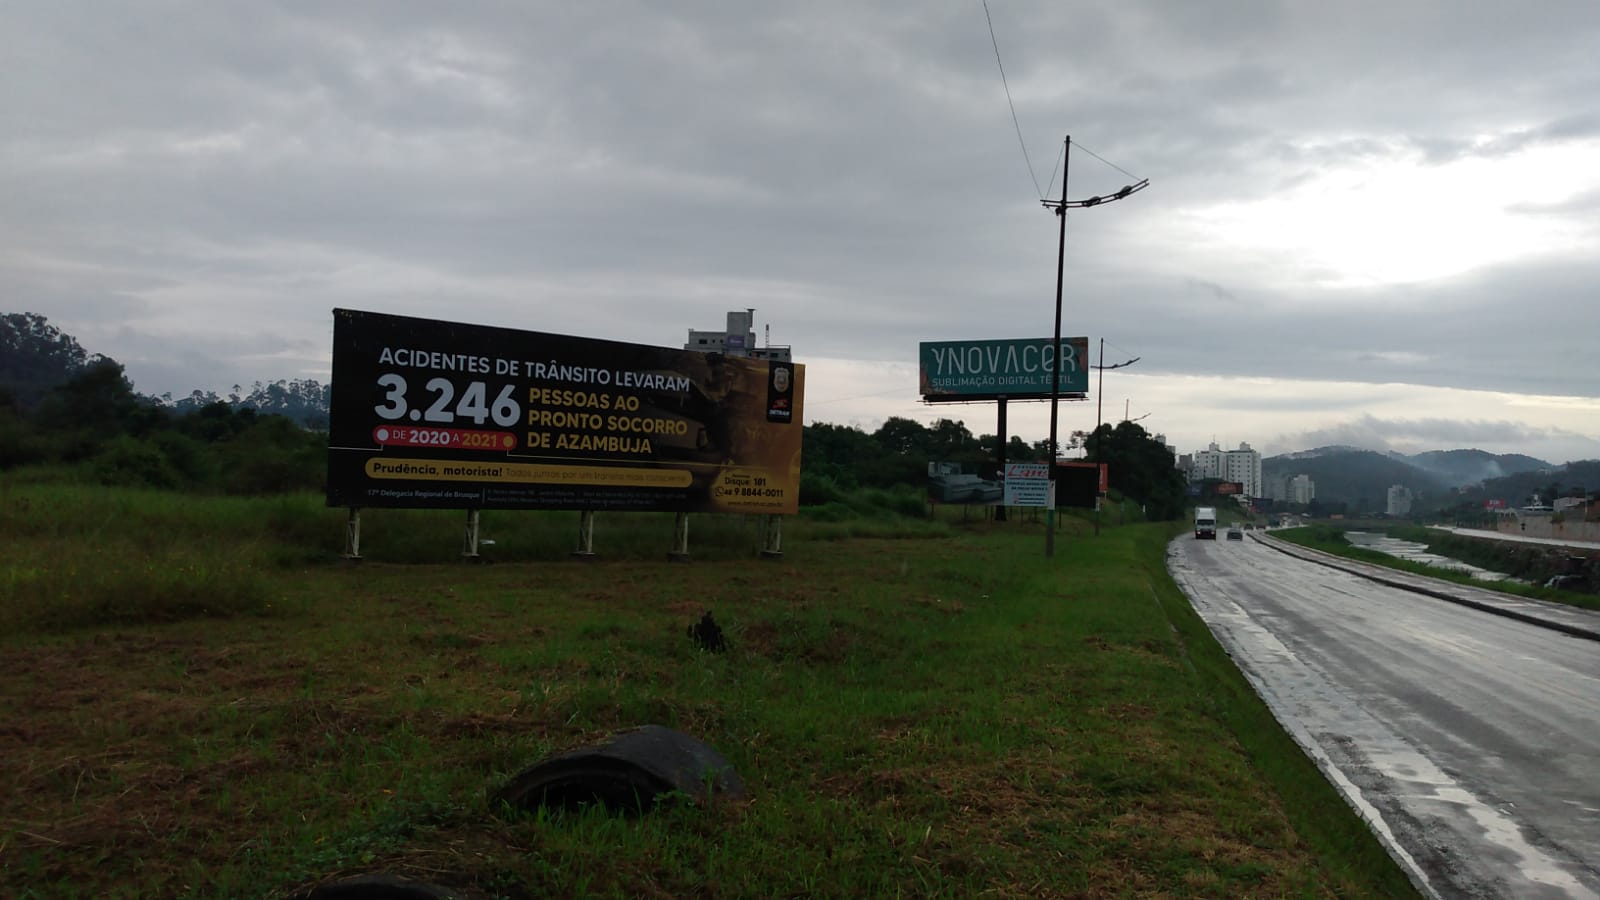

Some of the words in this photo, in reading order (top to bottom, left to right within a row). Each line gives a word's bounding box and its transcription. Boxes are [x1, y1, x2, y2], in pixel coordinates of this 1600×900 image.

[379, 347, 490, 374] ACIDENTES
[496, 360, 519, 376] DE
[525, 359, 611, 385] TRÂNSITO
[615, 371, 690, 392] LEVARAM
[932, 375, 995, 387] SUBLIMAÇÃO
[998, 376, 1037, 385] DIGITAL
[1040, 374, 1073, 385] TÊTIL
[374, 373, 521, 427] 3.246
[529, 387, 610, 410] PESSOAS
[615, 394, 639, 411] AO
[528, 410, 603, 430] PRONTO
[607, 415, 688, 435] SOCORRO
[392, 429, 406, 440] DE
[409, 430, 450, 445] 2020
[452, 433, 460, 442] A
[462, 432, 497, 447] 2021
[527, 432, 550, 448] DE
[556, 433, 652, 454] AZAMBUJA
[373, 462, 440, 476] Prudência,
[443, 465, 503, 477] motorista!
[380, 489, 413, 498] Delegacia
[444, 490, 453, 498] de
